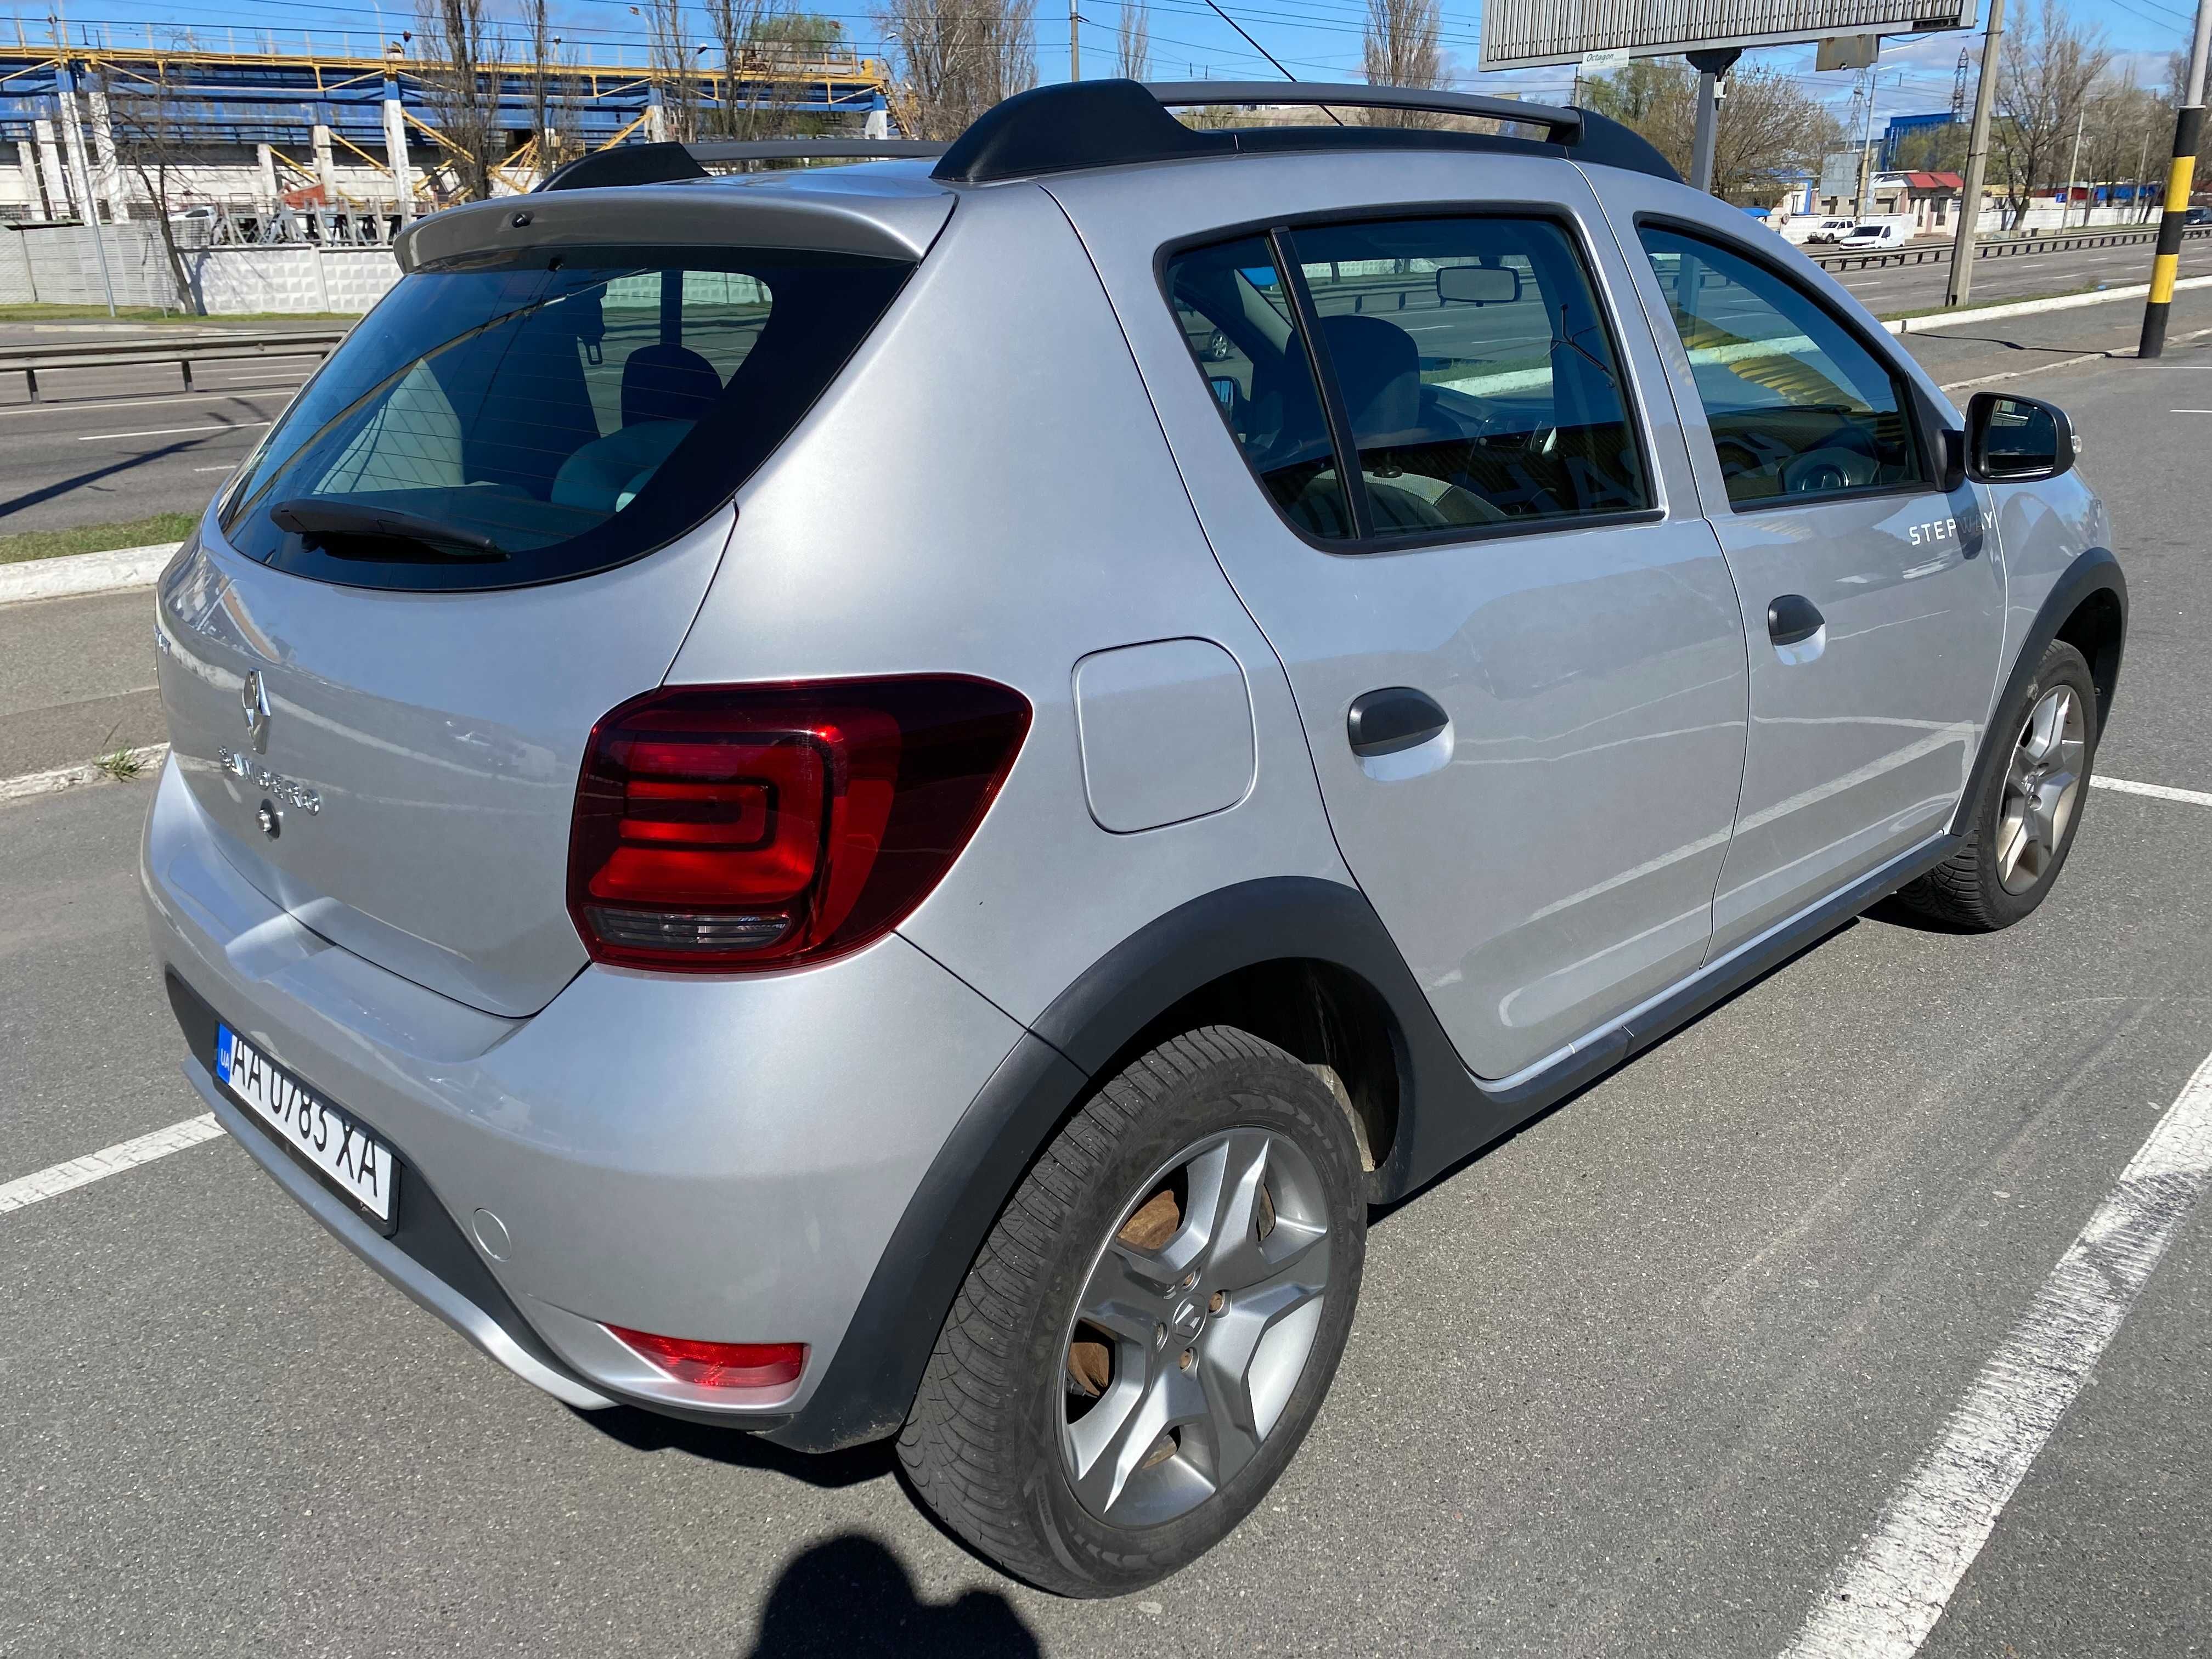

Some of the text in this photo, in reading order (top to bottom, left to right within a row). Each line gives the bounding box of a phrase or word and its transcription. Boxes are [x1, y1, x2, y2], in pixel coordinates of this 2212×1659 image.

[1587, 53, 1614, 63] Octagon
[1909, 511, 1993, 545] STEPWAY
[221, 1048, 229, 1071] UA
[232, 1039, 262, 1101] AA
[336, 1118, 377, 1198] XA
